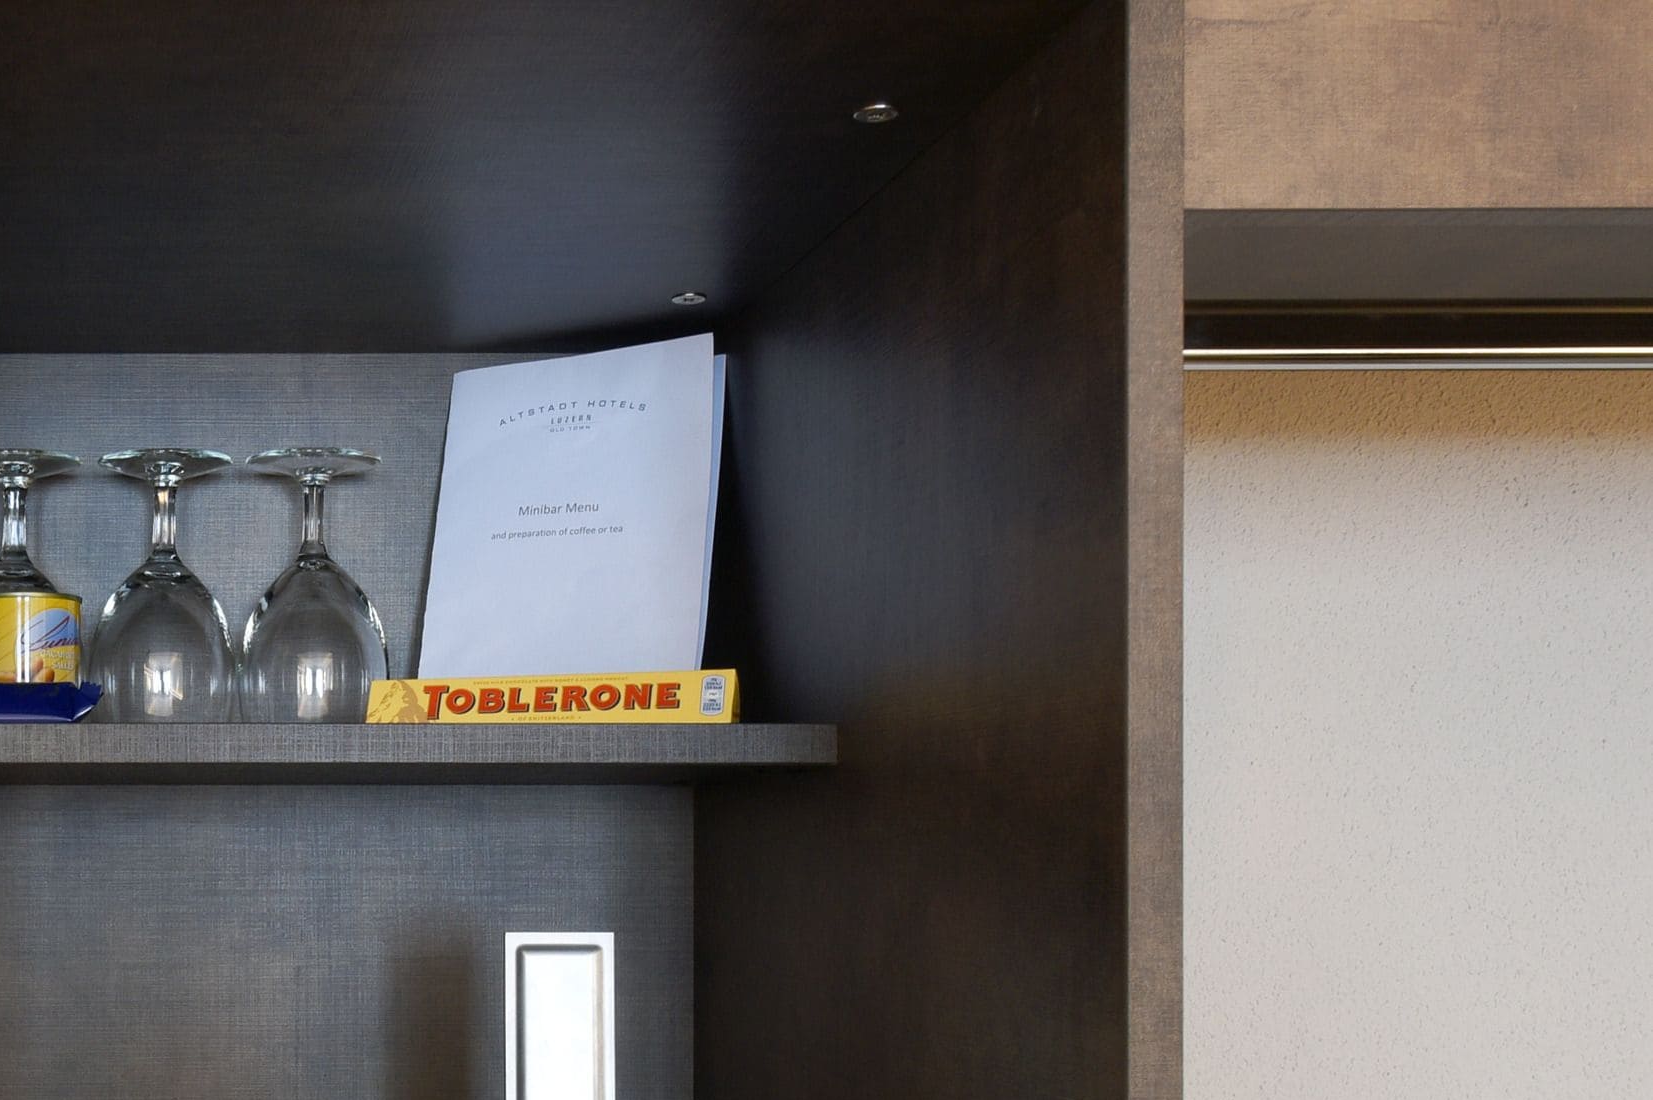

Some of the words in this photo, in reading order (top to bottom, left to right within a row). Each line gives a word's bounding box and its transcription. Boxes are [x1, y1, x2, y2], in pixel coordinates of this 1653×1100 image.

[499, 401, 578, 427] ALTSTADT
[587, 399, 647, 412] HOTELS
[518, 503, 563, 517] Minibar
[565, 502, 600, 513] Menu
[491, 530, 507, 540] and
[508, 528, 557, 541] preparation
[558, 527, 568, 537] of
[569, 526, 596, 536] coffee
[597, 526, 608, 534] or
[609, 525, 623, 533] tea
[423, 682, 681, 720] TOBLERONE
